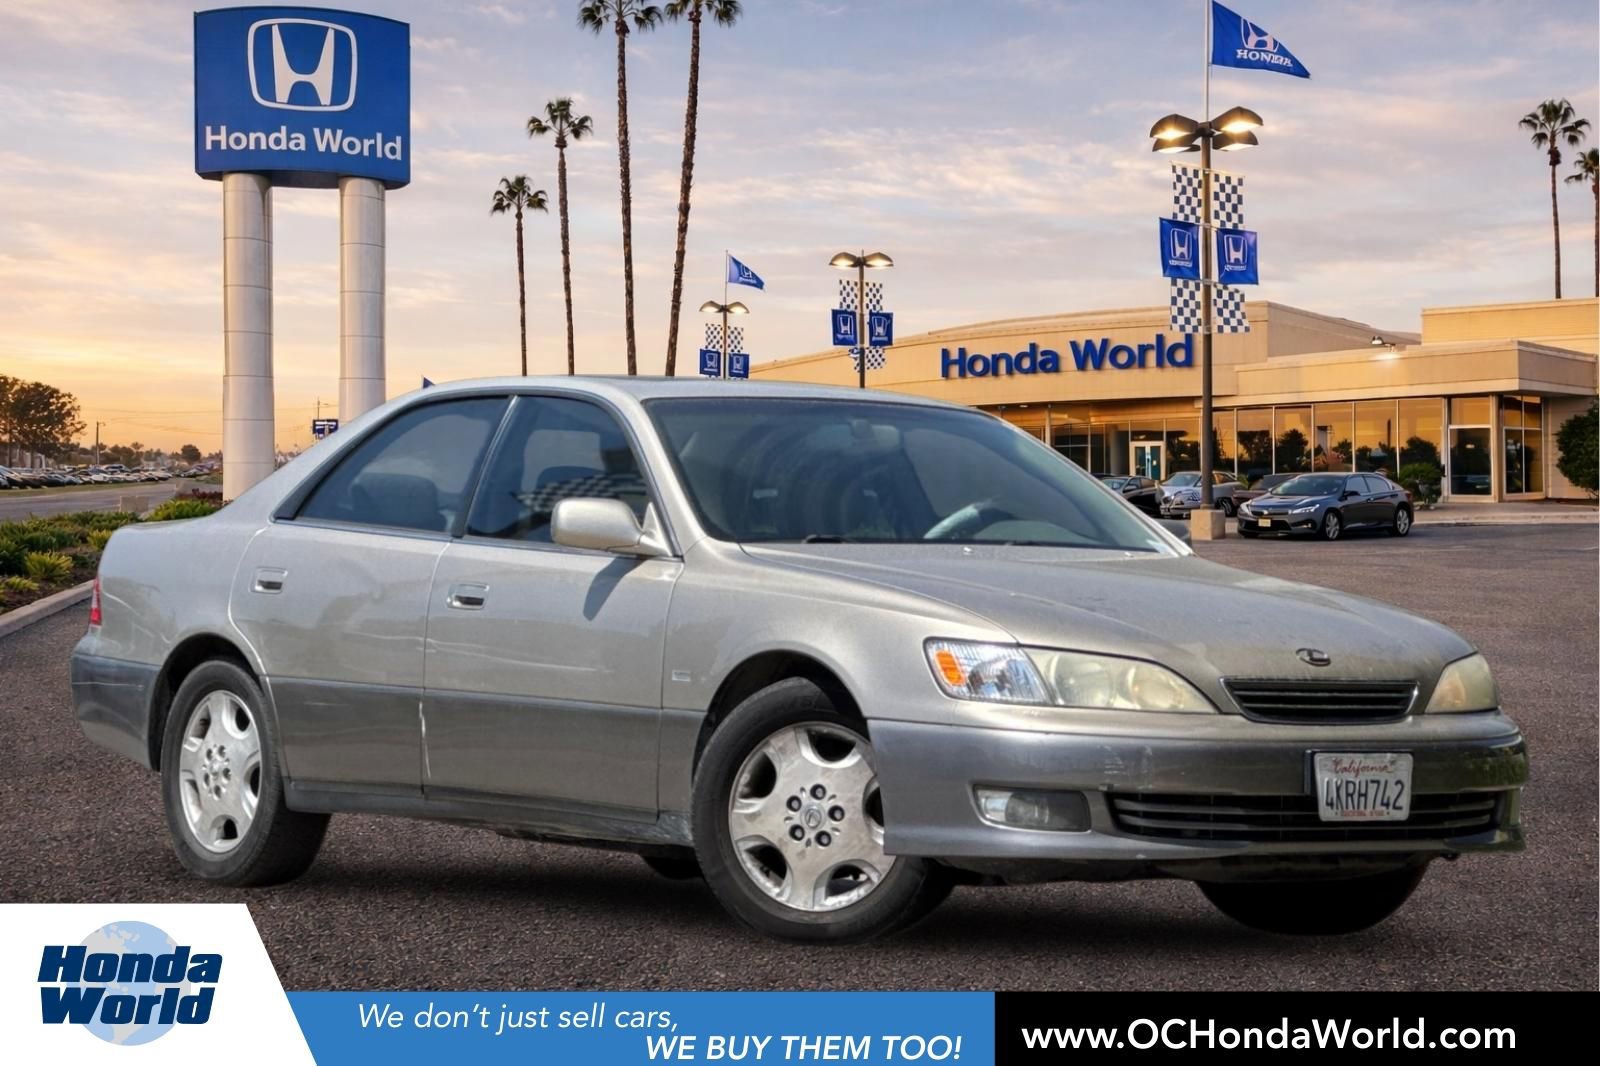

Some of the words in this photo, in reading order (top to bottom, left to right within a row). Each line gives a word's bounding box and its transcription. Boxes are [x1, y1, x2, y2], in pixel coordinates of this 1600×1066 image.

[205, 125, 306, 151] Honda
[312, 127, 402, 161] World
[941, 342, 1061, 378] Honda
[1069, 333, 1194, 371] World
[1332, 758, 1394, 777] California
[1325, 778, 1405, 810] 4KRH742
